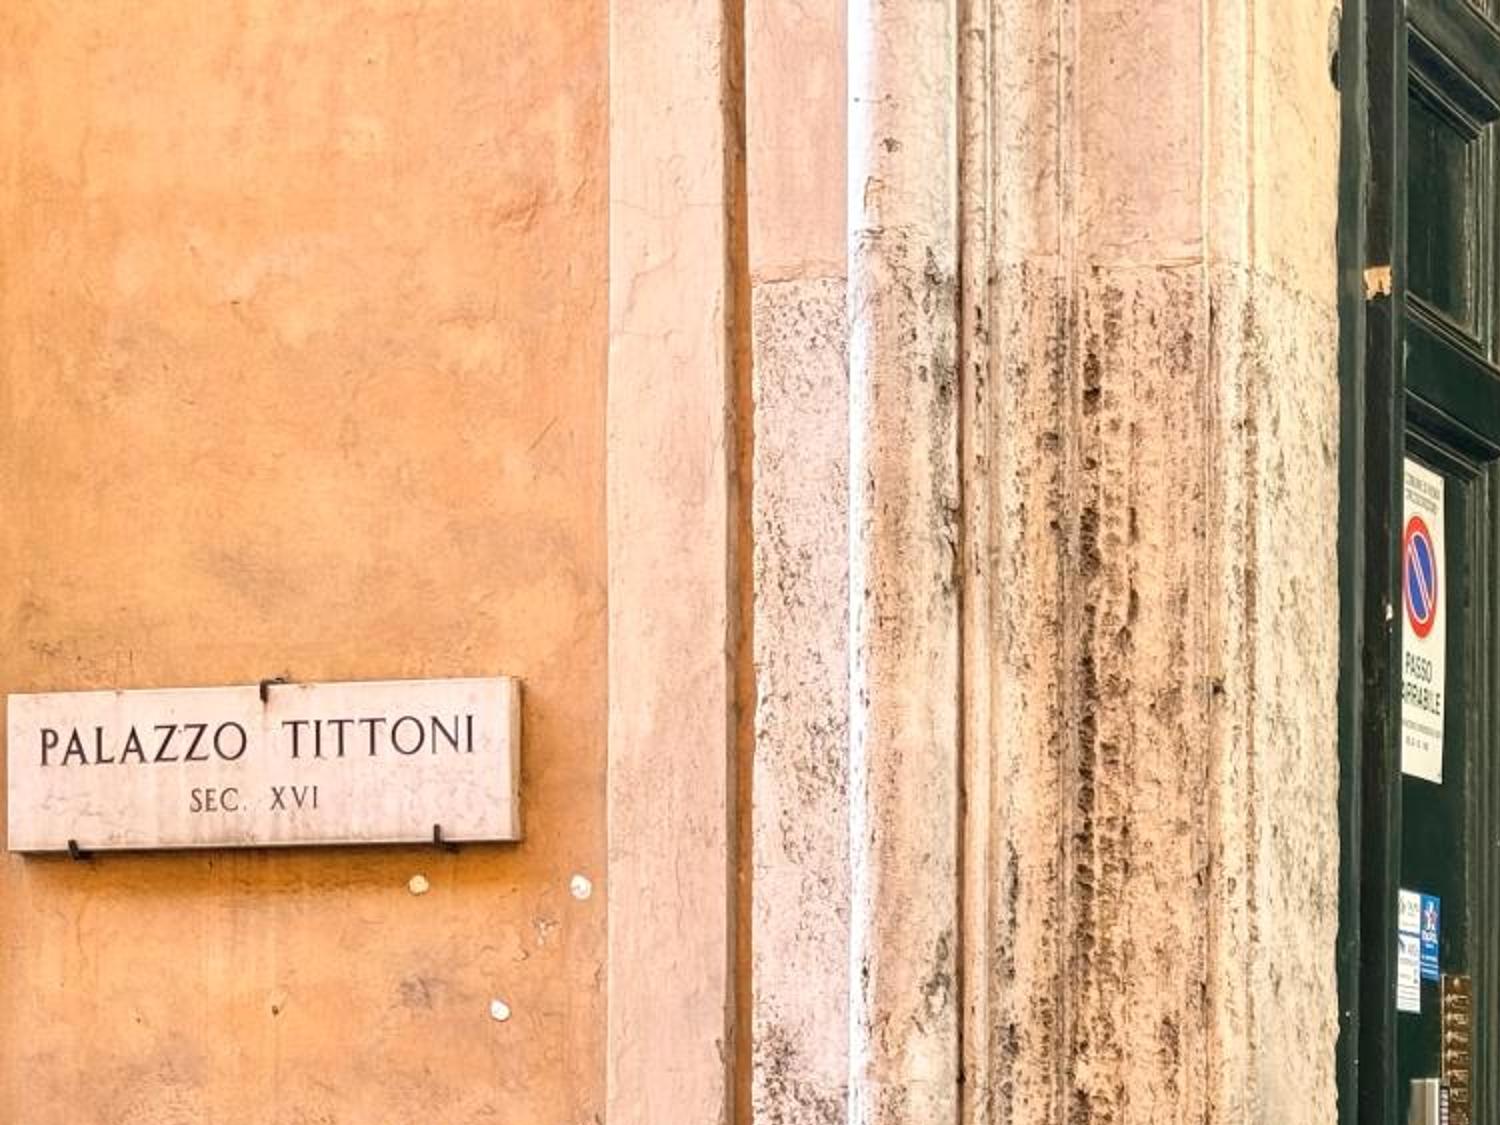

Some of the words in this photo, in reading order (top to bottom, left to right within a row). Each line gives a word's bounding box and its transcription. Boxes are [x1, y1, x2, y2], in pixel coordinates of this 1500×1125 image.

[1405, 651, 1433, 684] PASSO
[39, 721, 248, 767] PALAZZO
[281, 715, 474, 759] TITTONI
[270, 785, 319, 811] XVI
